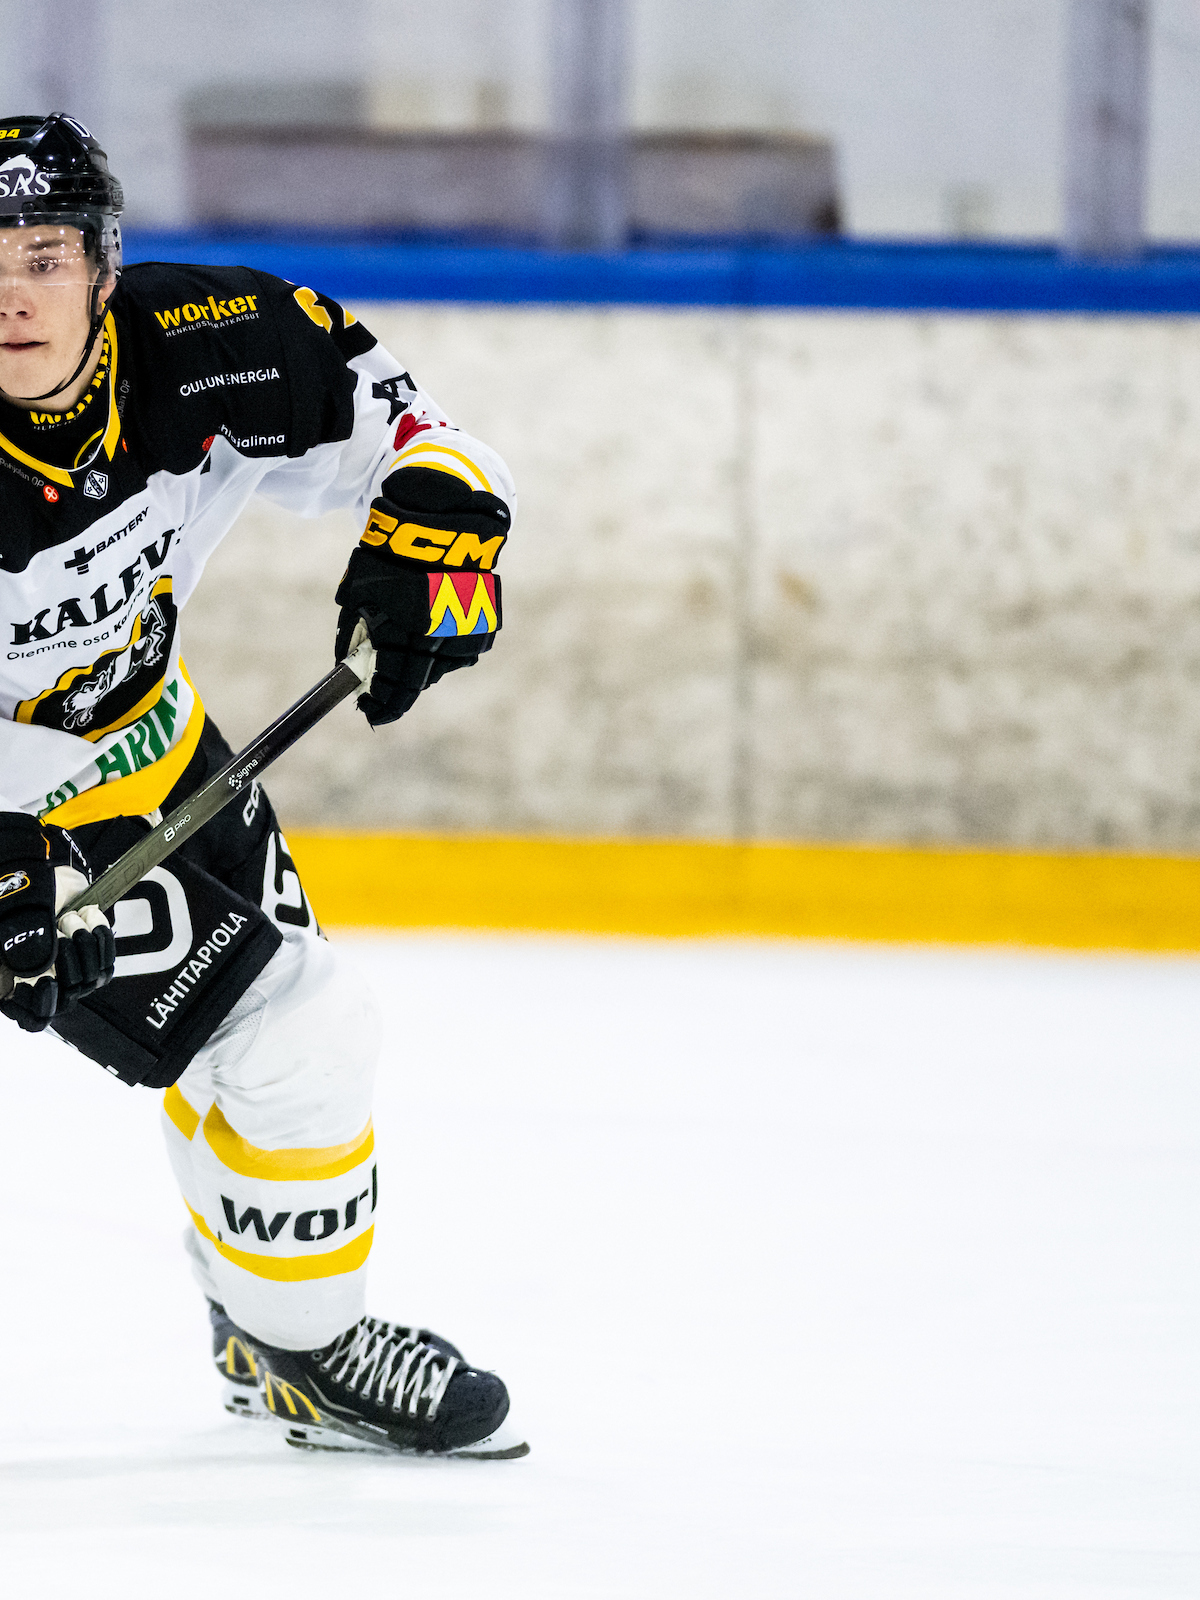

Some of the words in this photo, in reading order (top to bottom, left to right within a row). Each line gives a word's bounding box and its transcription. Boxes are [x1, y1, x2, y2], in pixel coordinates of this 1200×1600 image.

[154, 295, 258, 329] worker
[179, 374, 225, 397] OULUN
[96, 506, 150, 553] BATTERY
[360, 508, 505, 570] CCM
[10, 524, 184, 645] KALEV
[6, 640, 78, 660] Olemme
[83, 631, 110, 646] osa
[174, 814, 192, 832] PRO
[146, 911, 248, 1029] LÄHITAPIOLA
